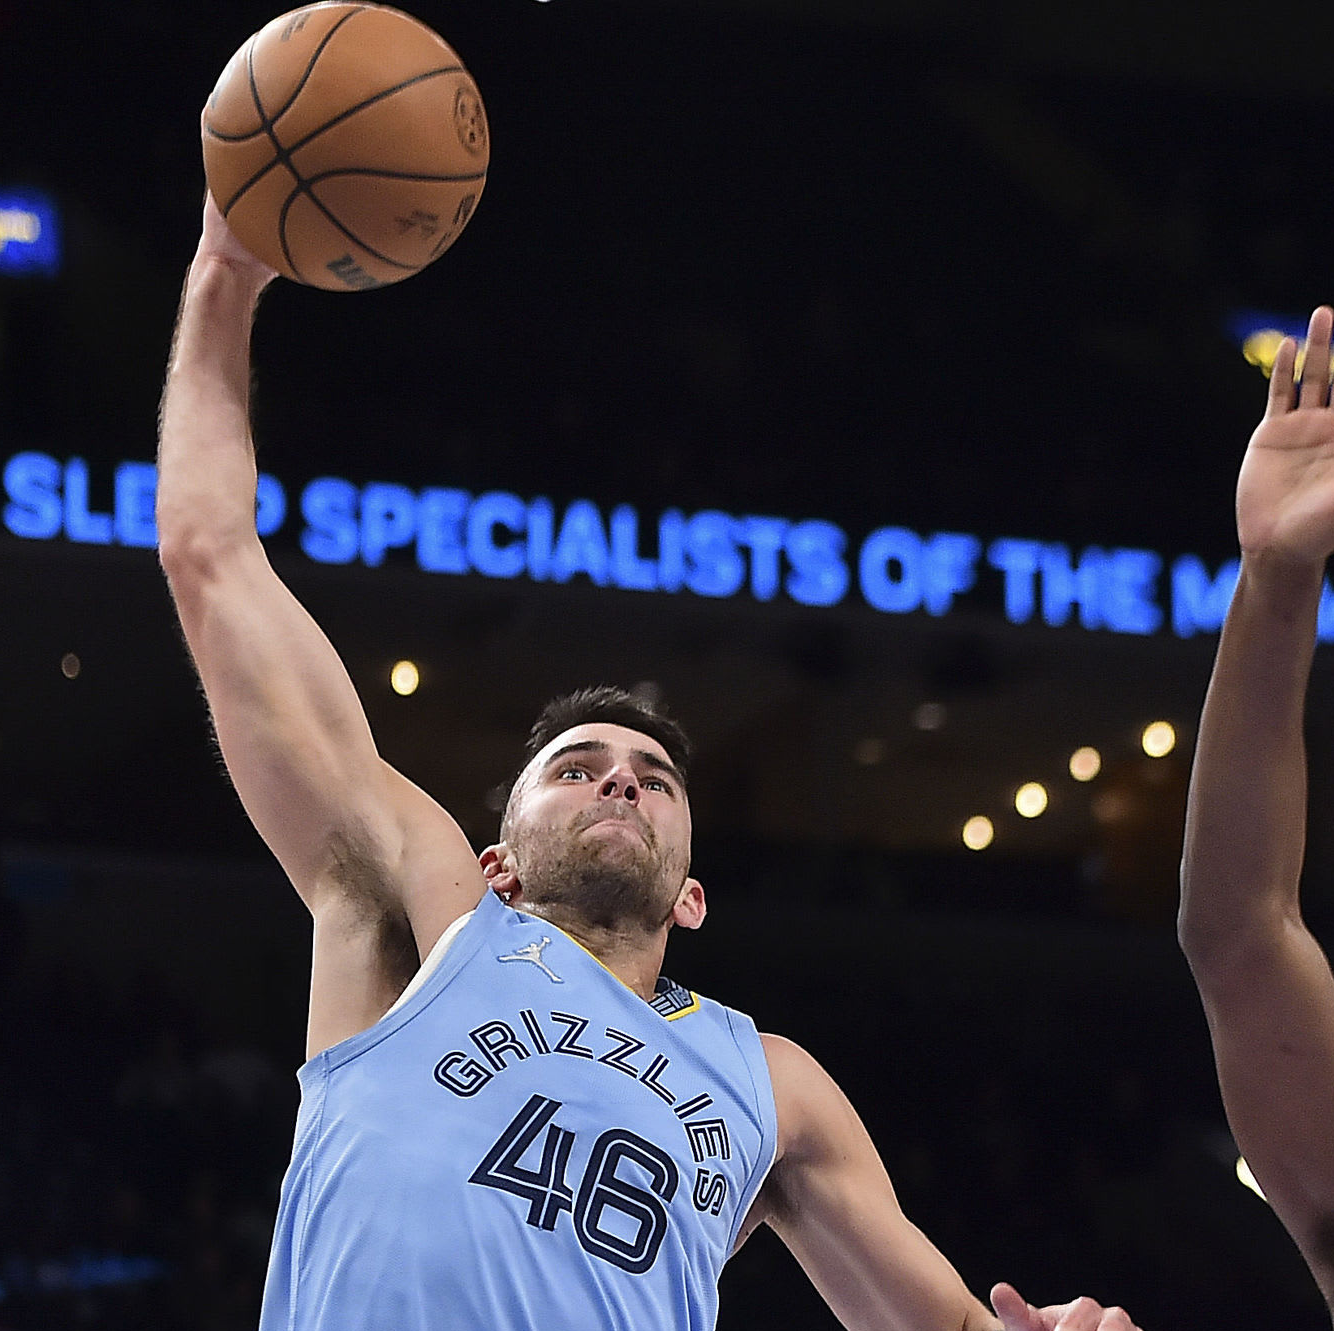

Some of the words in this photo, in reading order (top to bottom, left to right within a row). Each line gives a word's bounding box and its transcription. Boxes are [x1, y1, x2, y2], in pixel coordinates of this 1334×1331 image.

[2, 451, 287, 550] SLEP
[299, 475, 851, 608] SPECIALISTS
[857, 525, 983, 618] OF
[985, 536, 1165, 638] THE
[433, 1009, 732, 1218] GRIZZLIES
[468, 1093, 681, 1276] 46
